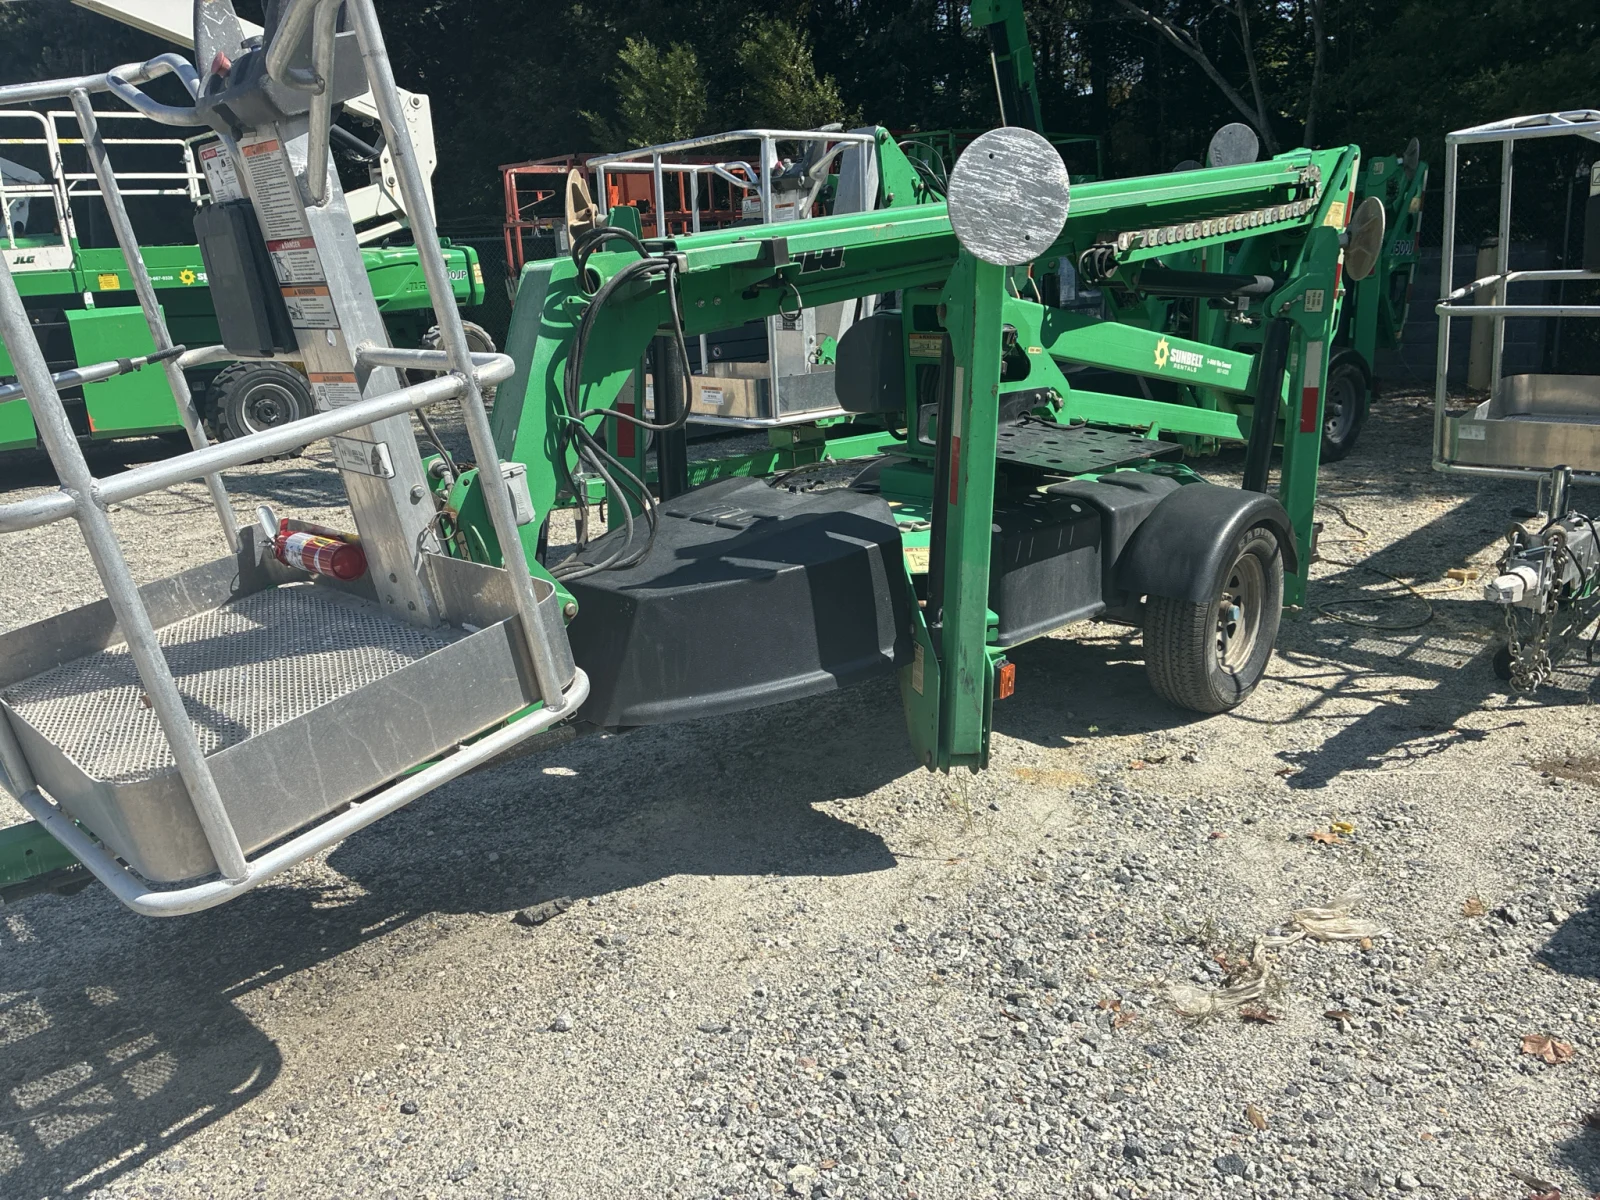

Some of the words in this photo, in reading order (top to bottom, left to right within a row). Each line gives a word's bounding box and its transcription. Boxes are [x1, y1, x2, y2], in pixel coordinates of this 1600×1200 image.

[285, 241, 301, 249] DANGER
[13, 256, 35, 264] JLG
[1170, 348, 1203, 368] SUNBELT
[1173, 362, 1197, 373] RENTALS
